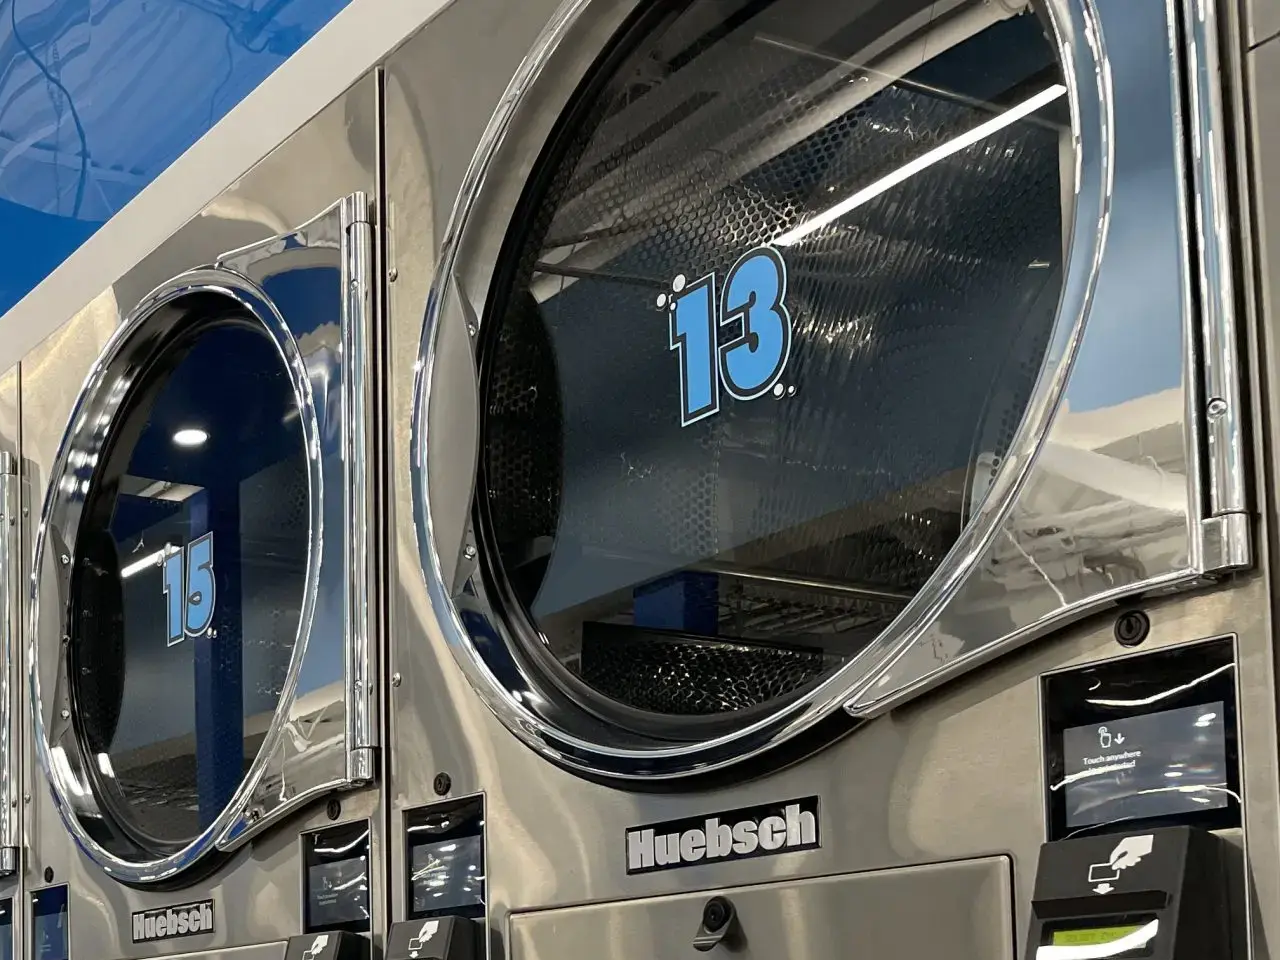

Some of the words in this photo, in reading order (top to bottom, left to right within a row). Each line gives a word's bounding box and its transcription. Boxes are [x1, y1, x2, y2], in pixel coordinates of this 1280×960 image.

[669, 246, 792, 427] 13
[163, 531, 216, 647] 15
[1083, 756, 1105, 766] Touch
[628, 804, 817, 870] Huebsch
[133, 902, 213, 940] Huebsch
